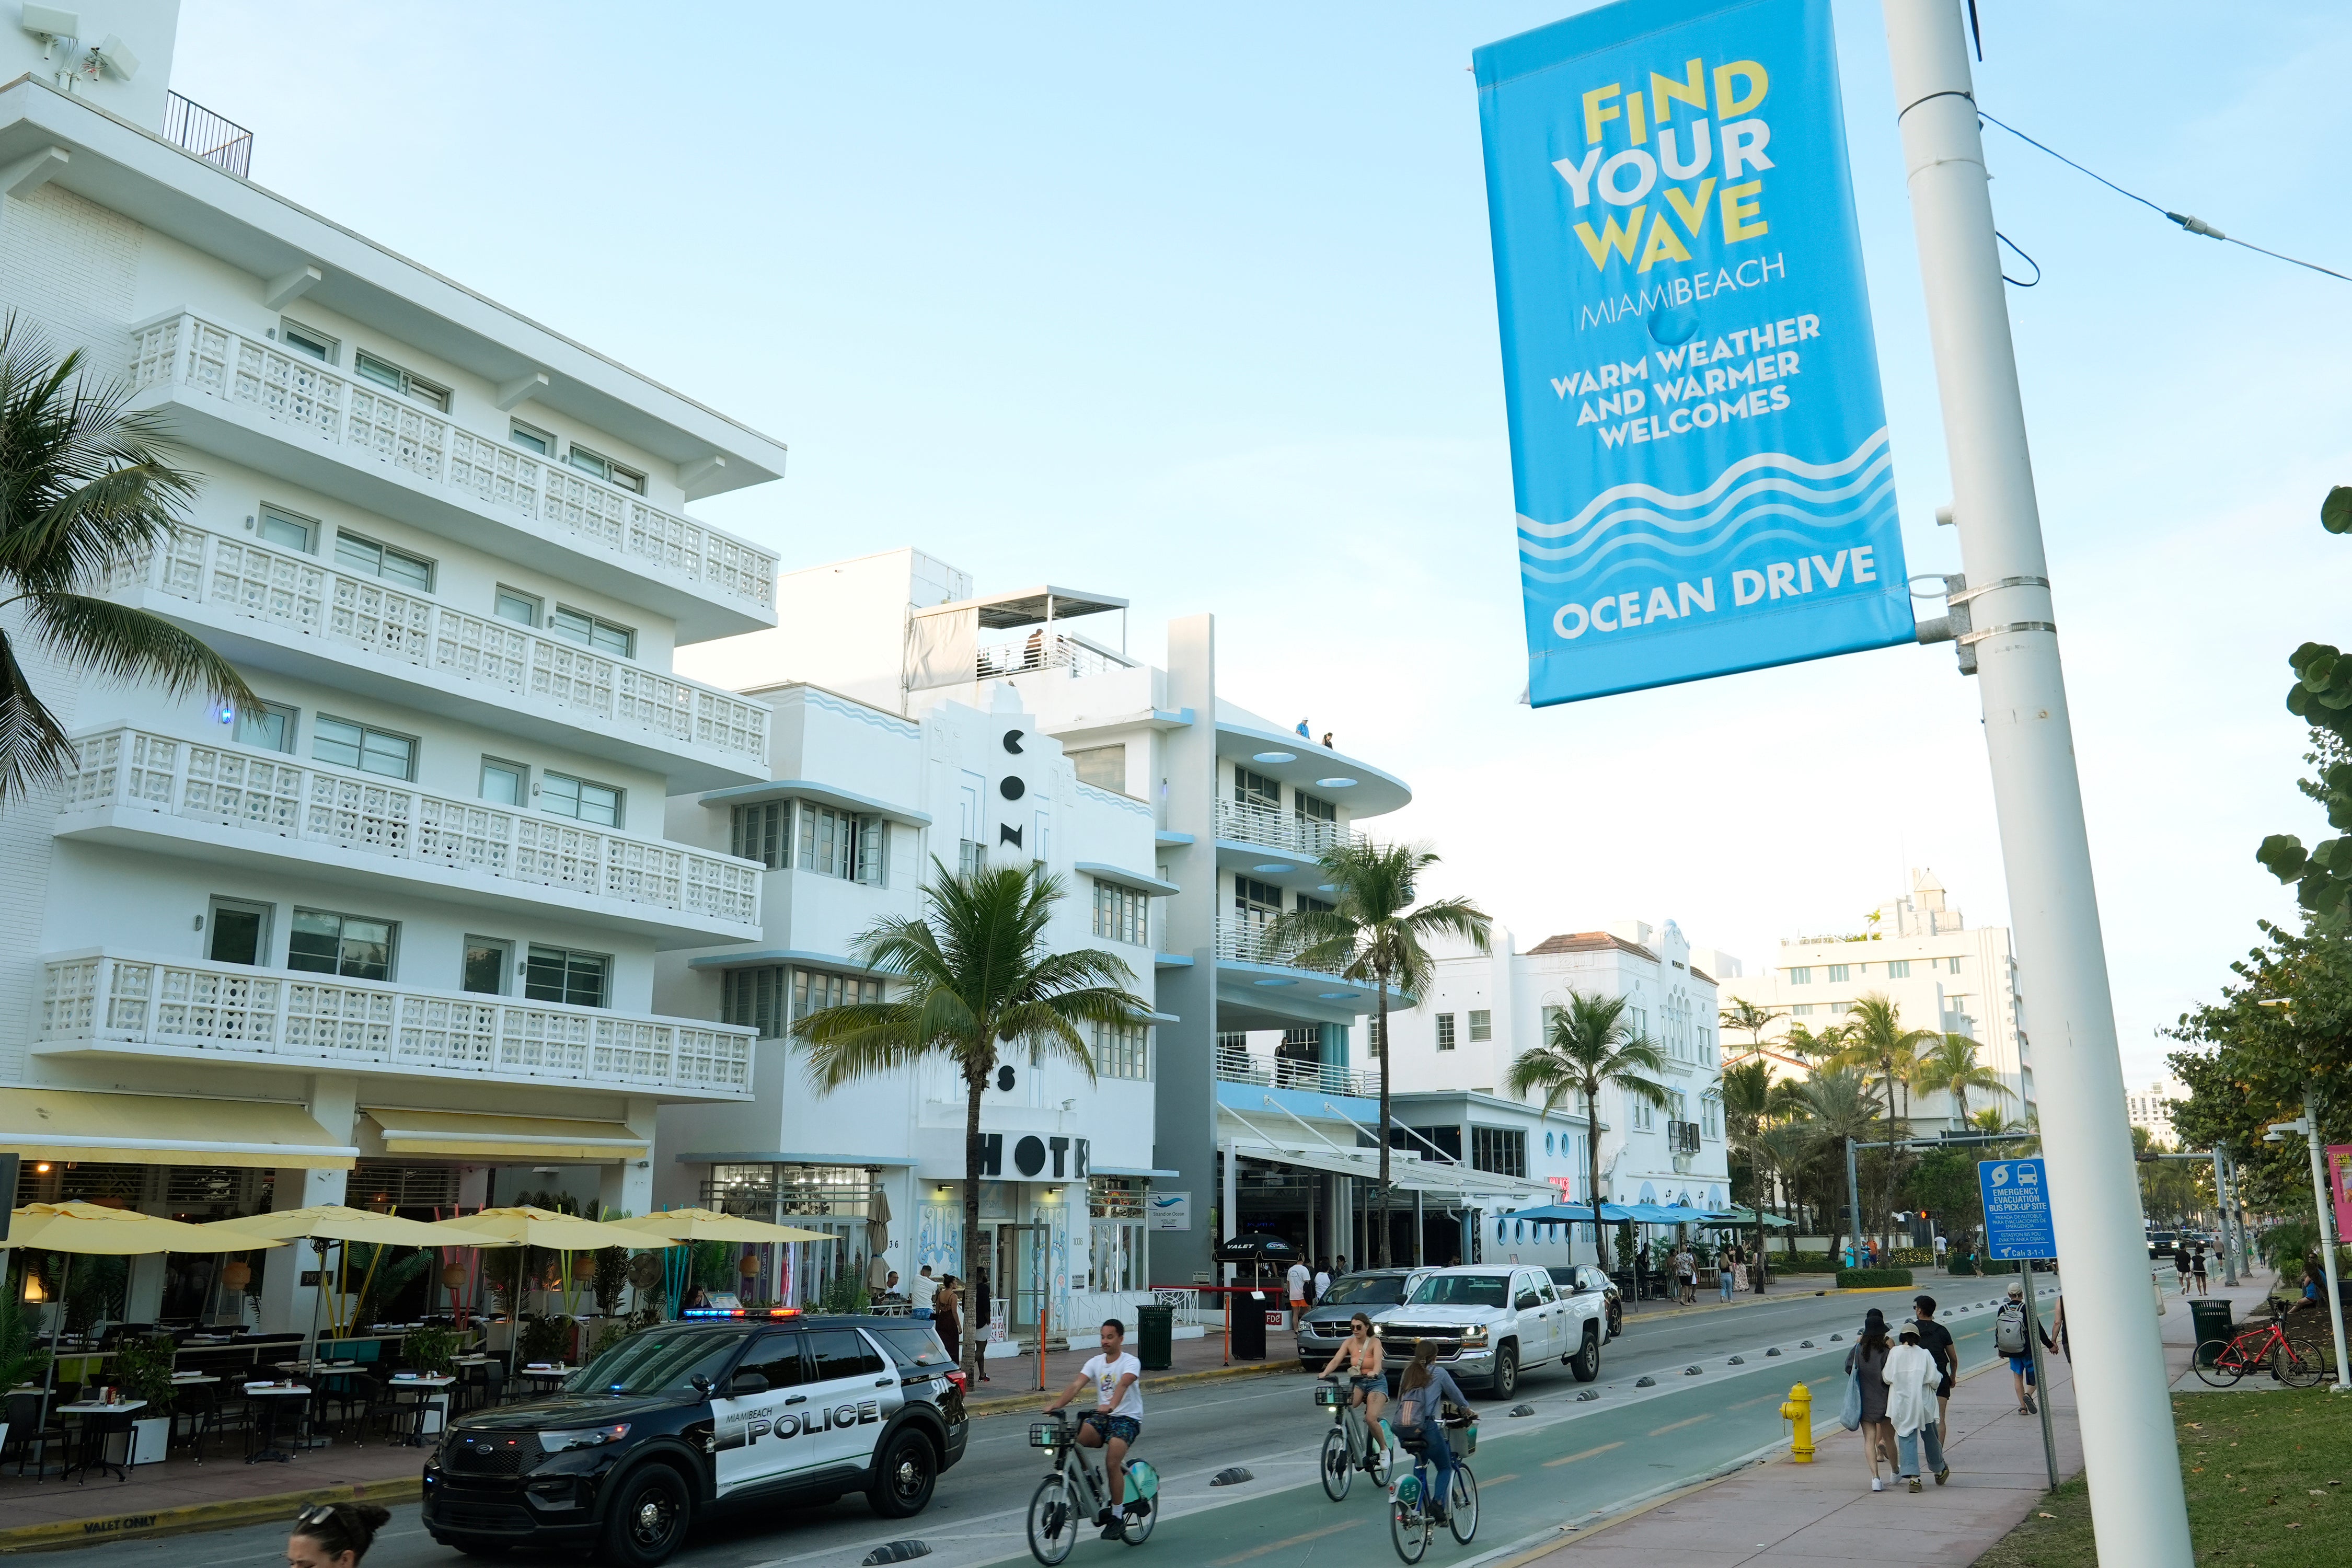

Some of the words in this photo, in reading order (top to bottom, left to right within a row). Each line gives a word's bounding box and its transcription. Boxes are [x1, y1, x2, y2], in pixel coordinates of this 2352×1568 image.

[1582, 57, 1769, 147] FIND
[1552, 118, 1775, 209] YOUR
[1573, 177, 1769, 274] WAVE
[1550, 355, 1647, 399] WARM
[1655, 314, 1820, 374] WEATHER
[1576, 388, 1645, 428] AND
[1652, 350, 1801, 406] WARMER
[1598, 384, 1791, 451] WELCOMES
[1552, 577, 1715, 640] OCEAN
[1732, 545, 1877, 601] DRIVE
[1992, 1187, 2039, 1196] EMERGENCY
[1993, 1195, 2040, 1204] EVACUATION
[1073, 1237, 1083, 1246] 1036
[931, 1378, 949, 1395] 911
[747, 1400, 879, 1446] POLICE
[84, 1519, 120, 1534] VALET
[123, 1515, 157, 1529] ONLY
